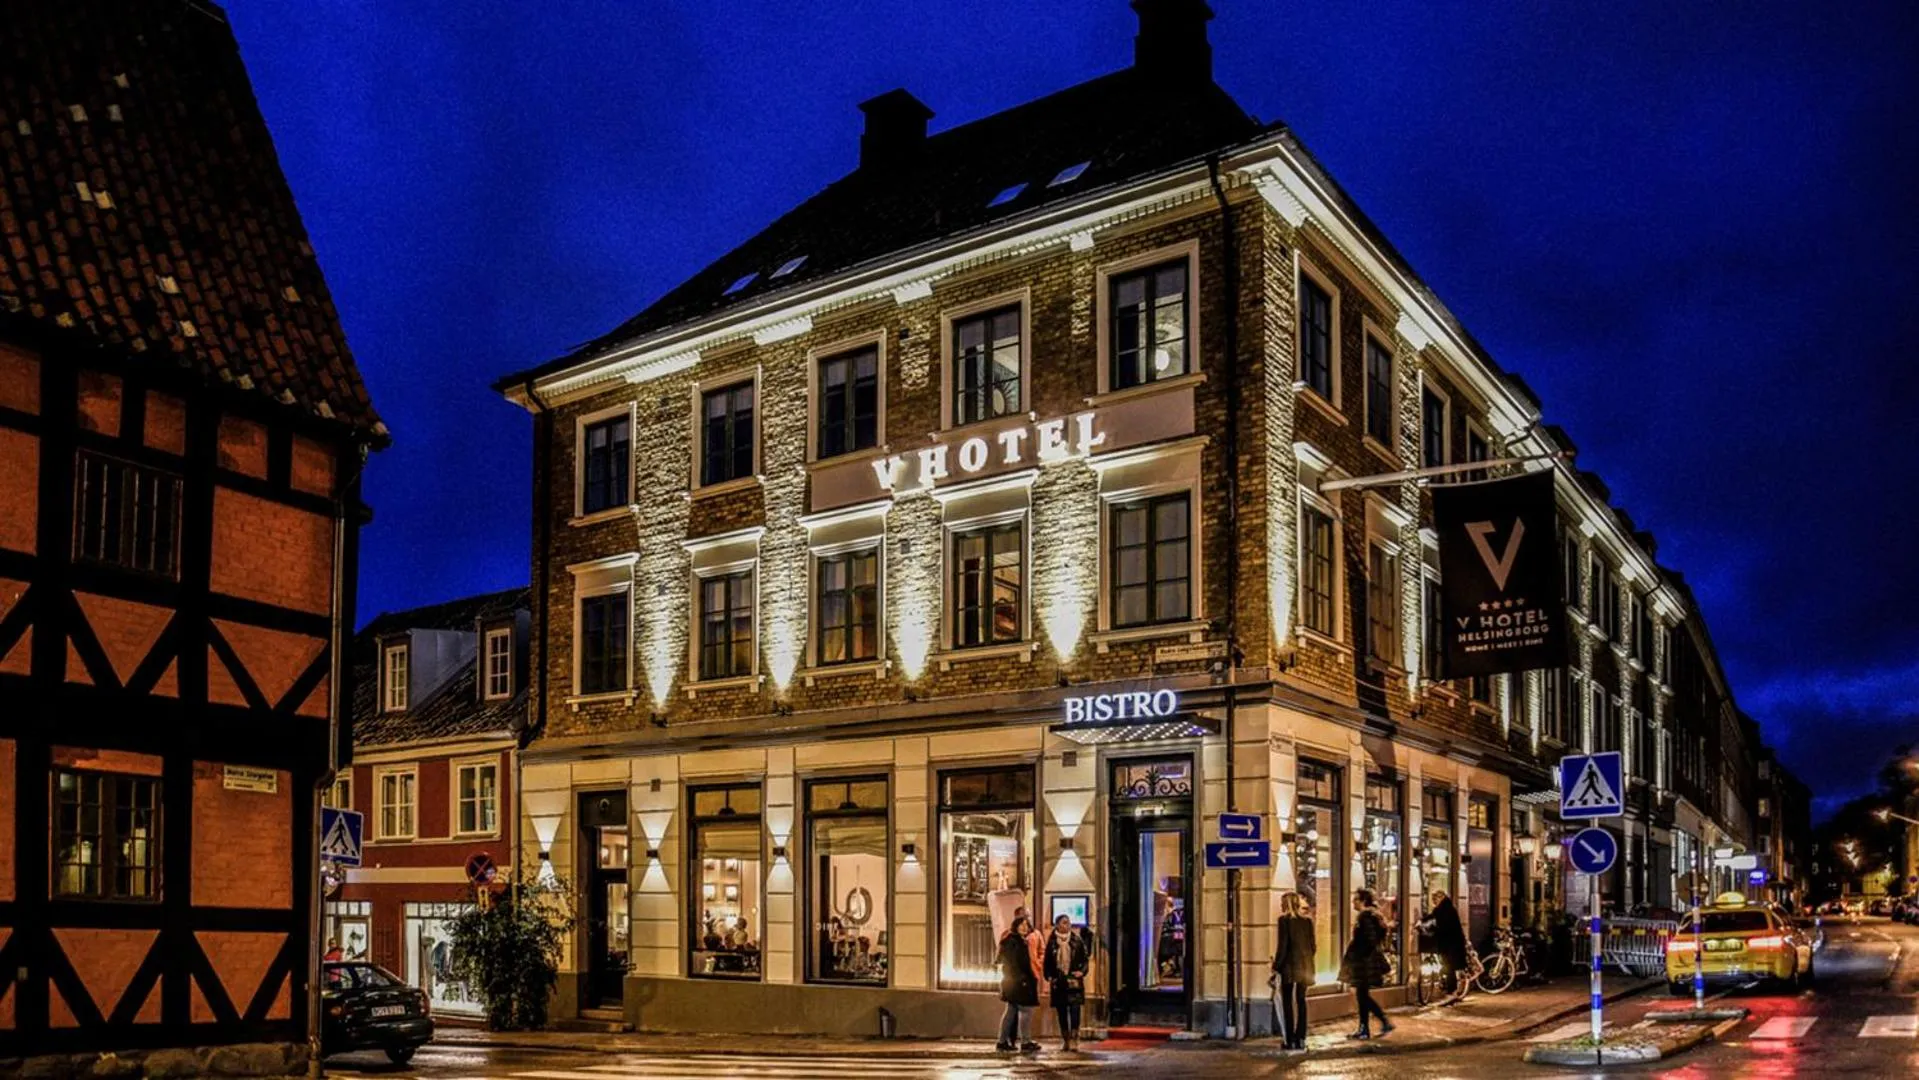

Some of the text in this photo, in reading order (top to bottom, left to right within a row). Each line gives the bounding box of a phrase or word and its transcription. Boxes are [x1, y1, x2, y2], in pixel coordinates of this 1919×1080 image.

[872, 412, 1106, 490] V HOTEL
[1456, 608, 1548, 630] V HOTEL
[1458, 623, 1550, 643] HELSINGBORG
[1063, 688, 1177, 723] BISTRO
